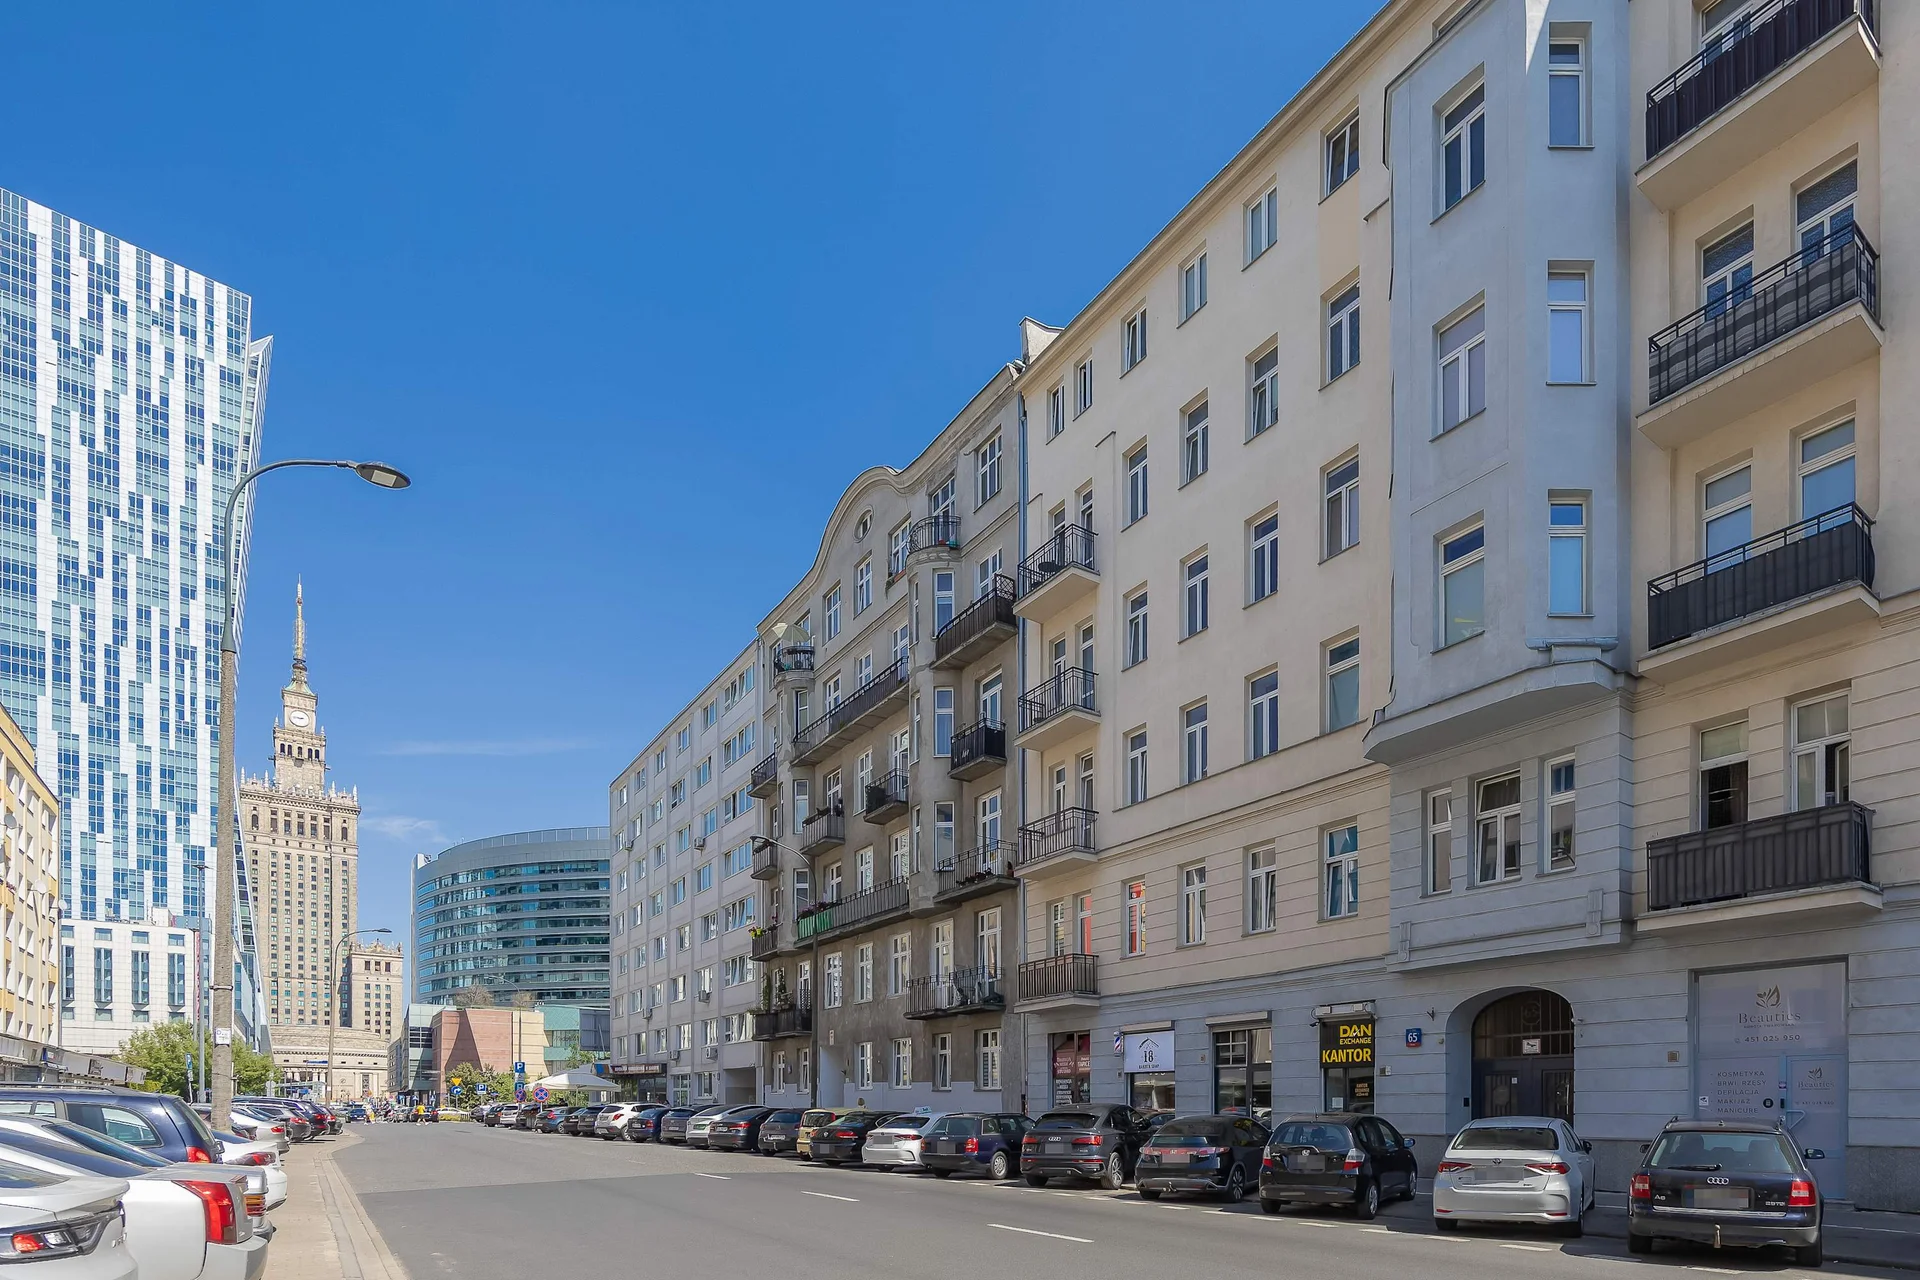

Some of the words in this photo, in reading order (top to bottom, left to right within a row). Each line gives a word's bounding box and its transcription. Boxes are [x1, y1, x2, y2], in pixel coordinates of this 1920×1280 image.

[1739, 1011, 1801, 1024] Beauties
[1340, 1024, 1372, 1037] DAN
[1408, 1032, 1418, 1043] 65
[1322, 1048, 1372, 1063] KANTOR
